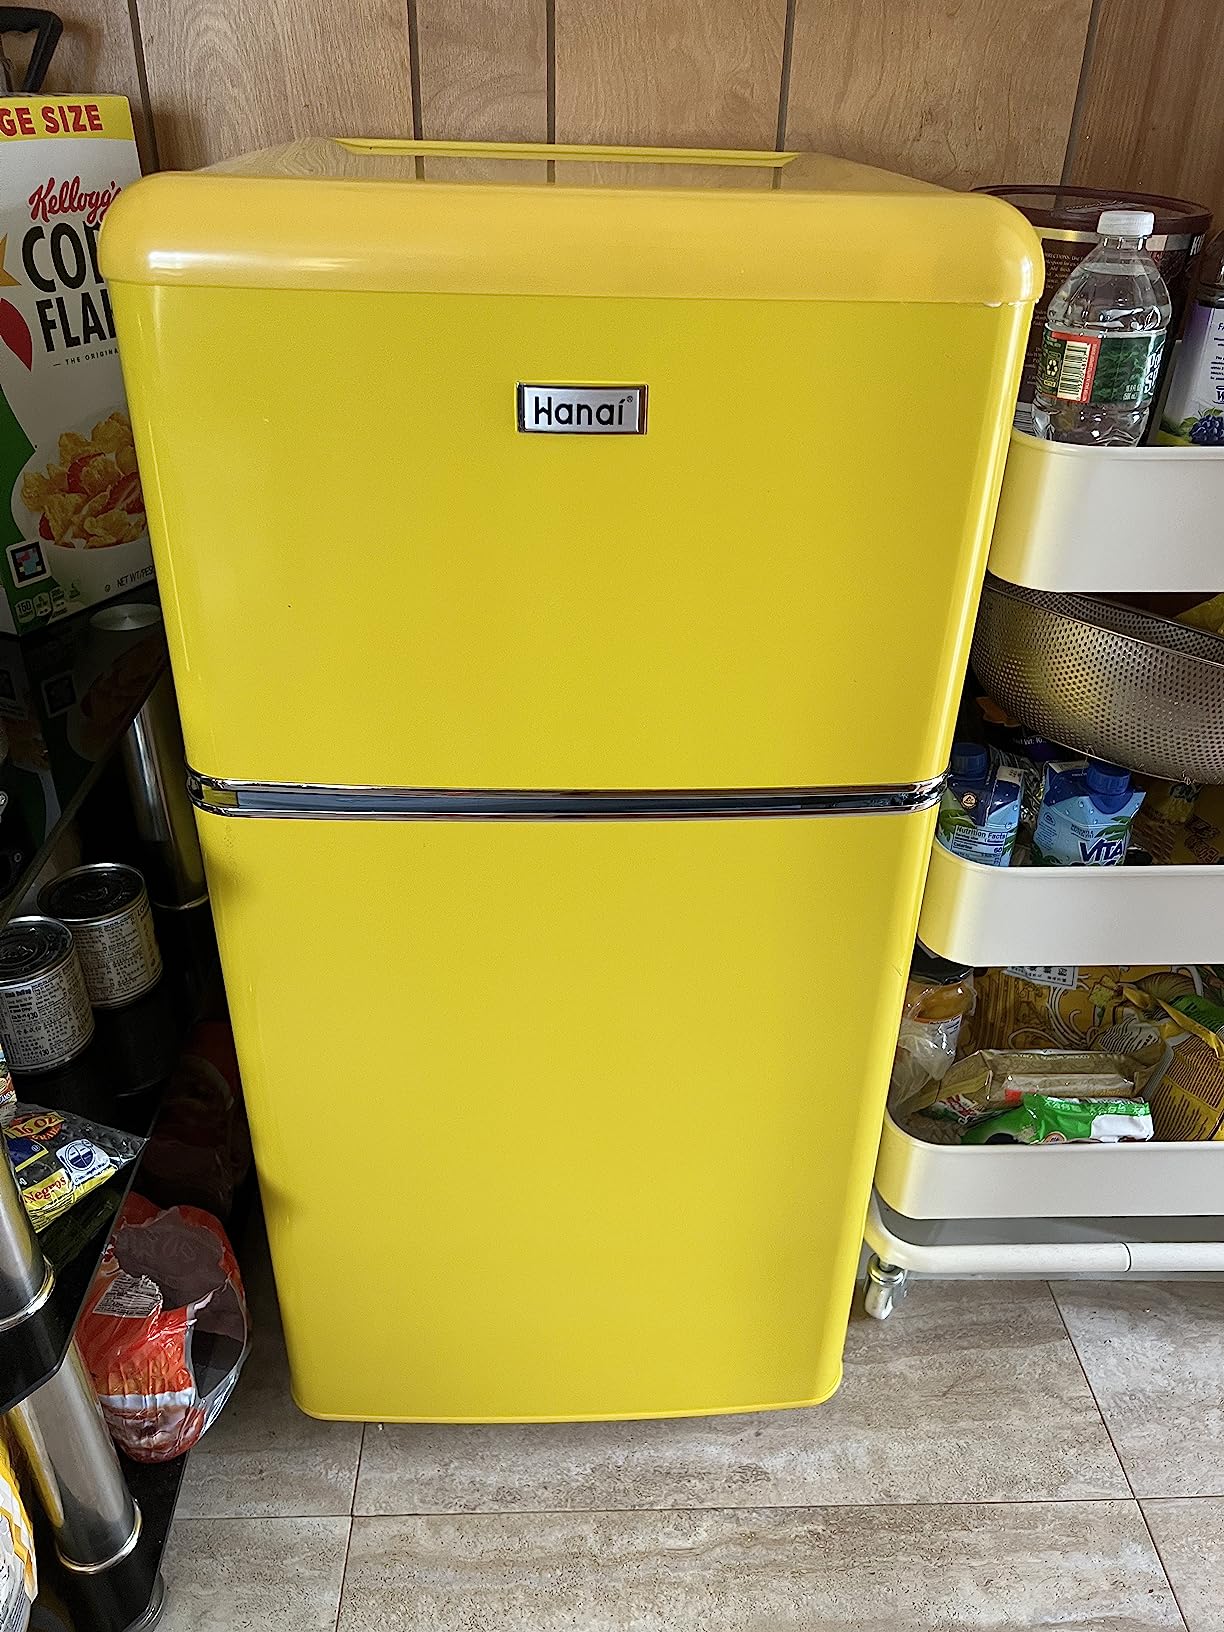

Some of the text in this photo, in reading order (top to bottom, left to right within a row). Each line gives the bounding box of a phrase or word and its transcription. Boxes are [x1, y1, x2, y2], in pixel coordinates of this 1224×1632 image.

[0, 104, 103, 137] GE SIZE
[65, 358, 81, 366] THE
[956, 825, 1006, 840] Nutrition Facts
[1078, 838, 1124, 863] VITA
[24, 1176, 67, 1203] Negros
